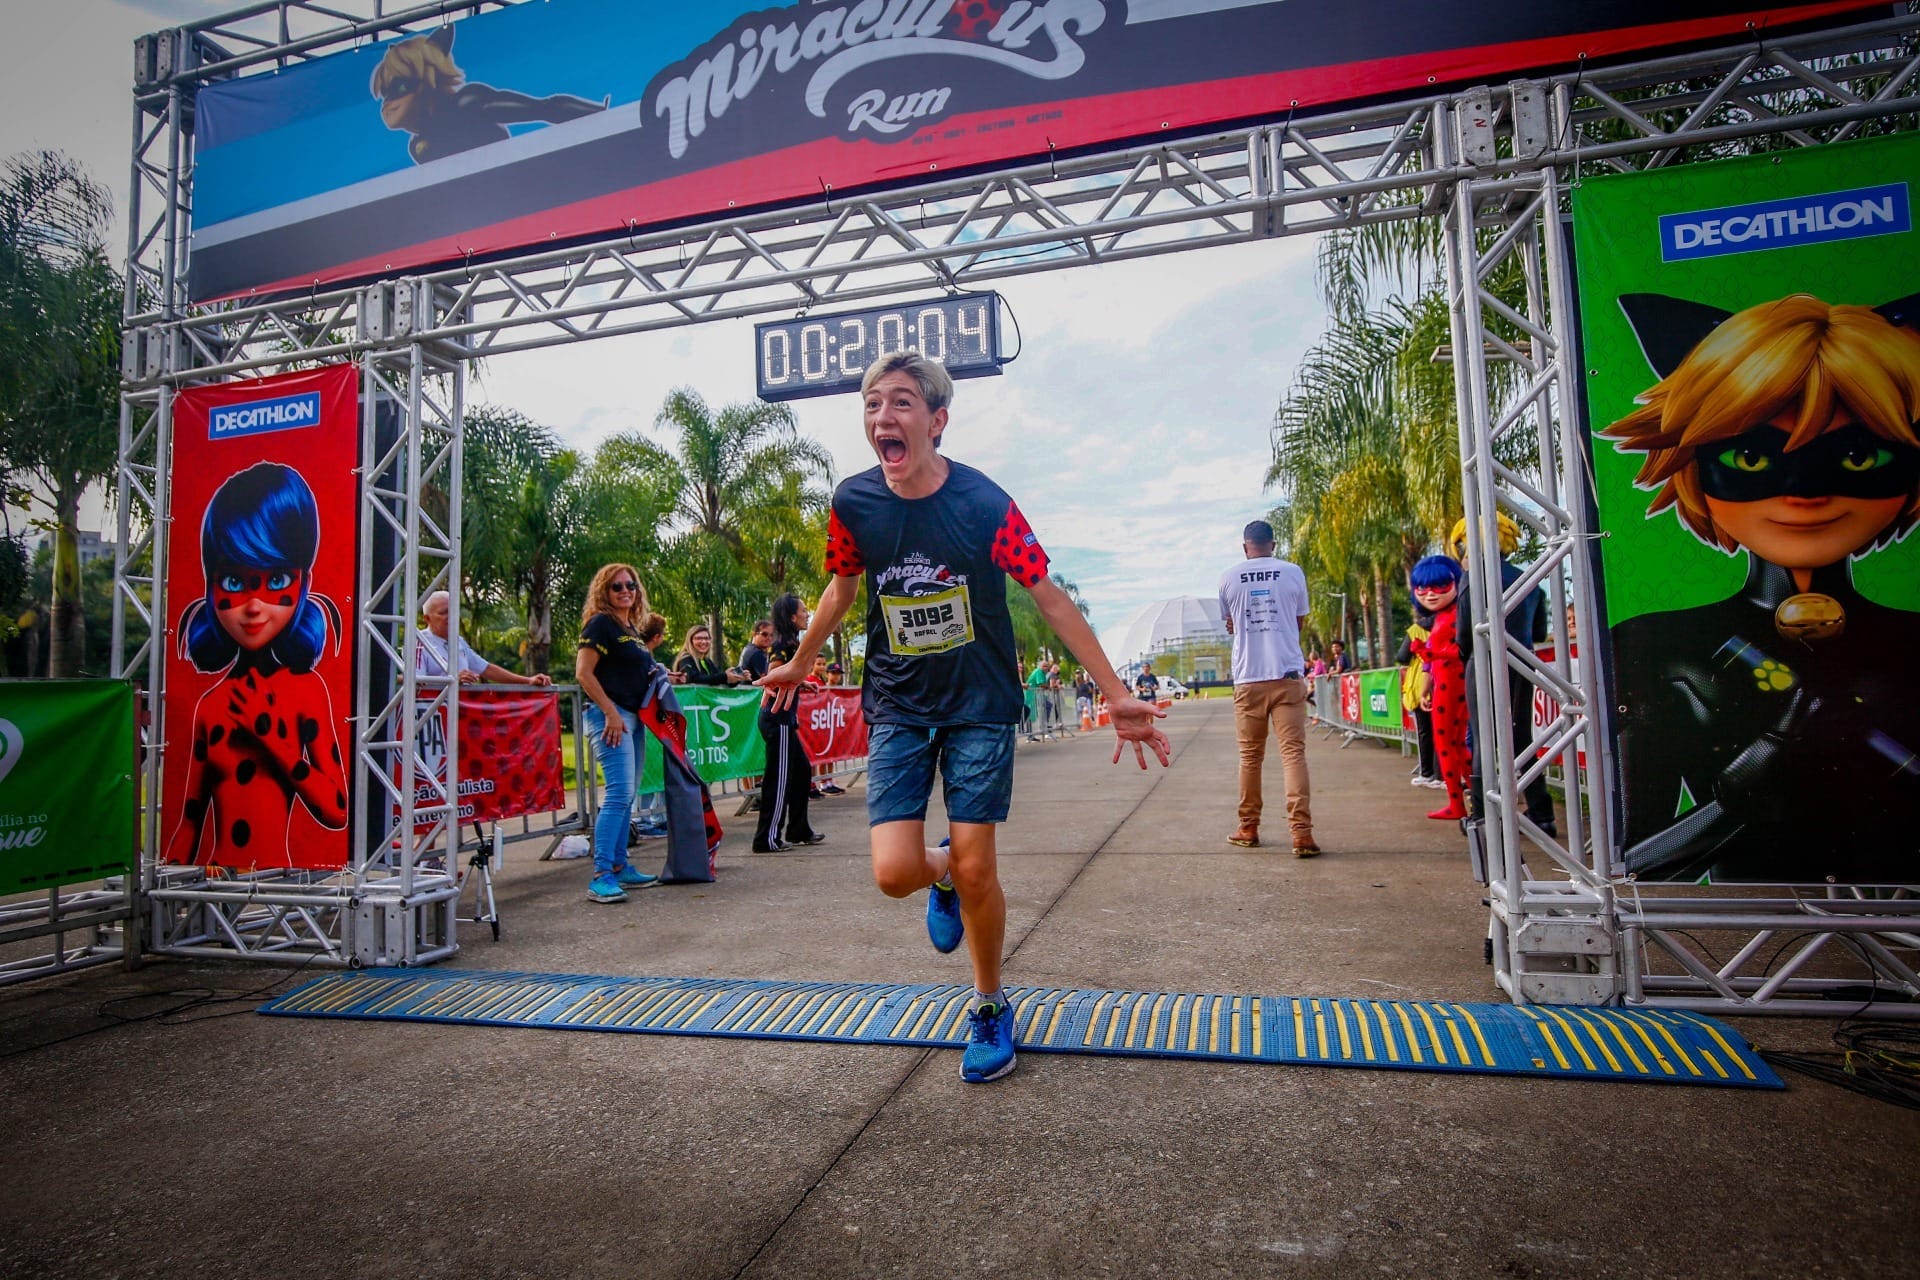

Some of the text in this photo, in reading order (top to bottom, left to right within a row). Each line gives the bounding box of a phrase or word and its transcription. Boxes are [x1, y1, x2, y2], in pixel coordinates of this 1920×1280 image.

[847, 87, 952, 133] Run
[1673, 196, 1895, 250] DECATHLON
[763, 303, 988, 385] 00:20:04
[215, 400, 314, 432] DECATHLON
[1240, 571, 1281, 584] STAFF
[900, 603, 954, 628] 3092
[684, 705, 731, 743] TS
[810, 696, 846, 756] selfit
[28, 813, 48, 824] no
